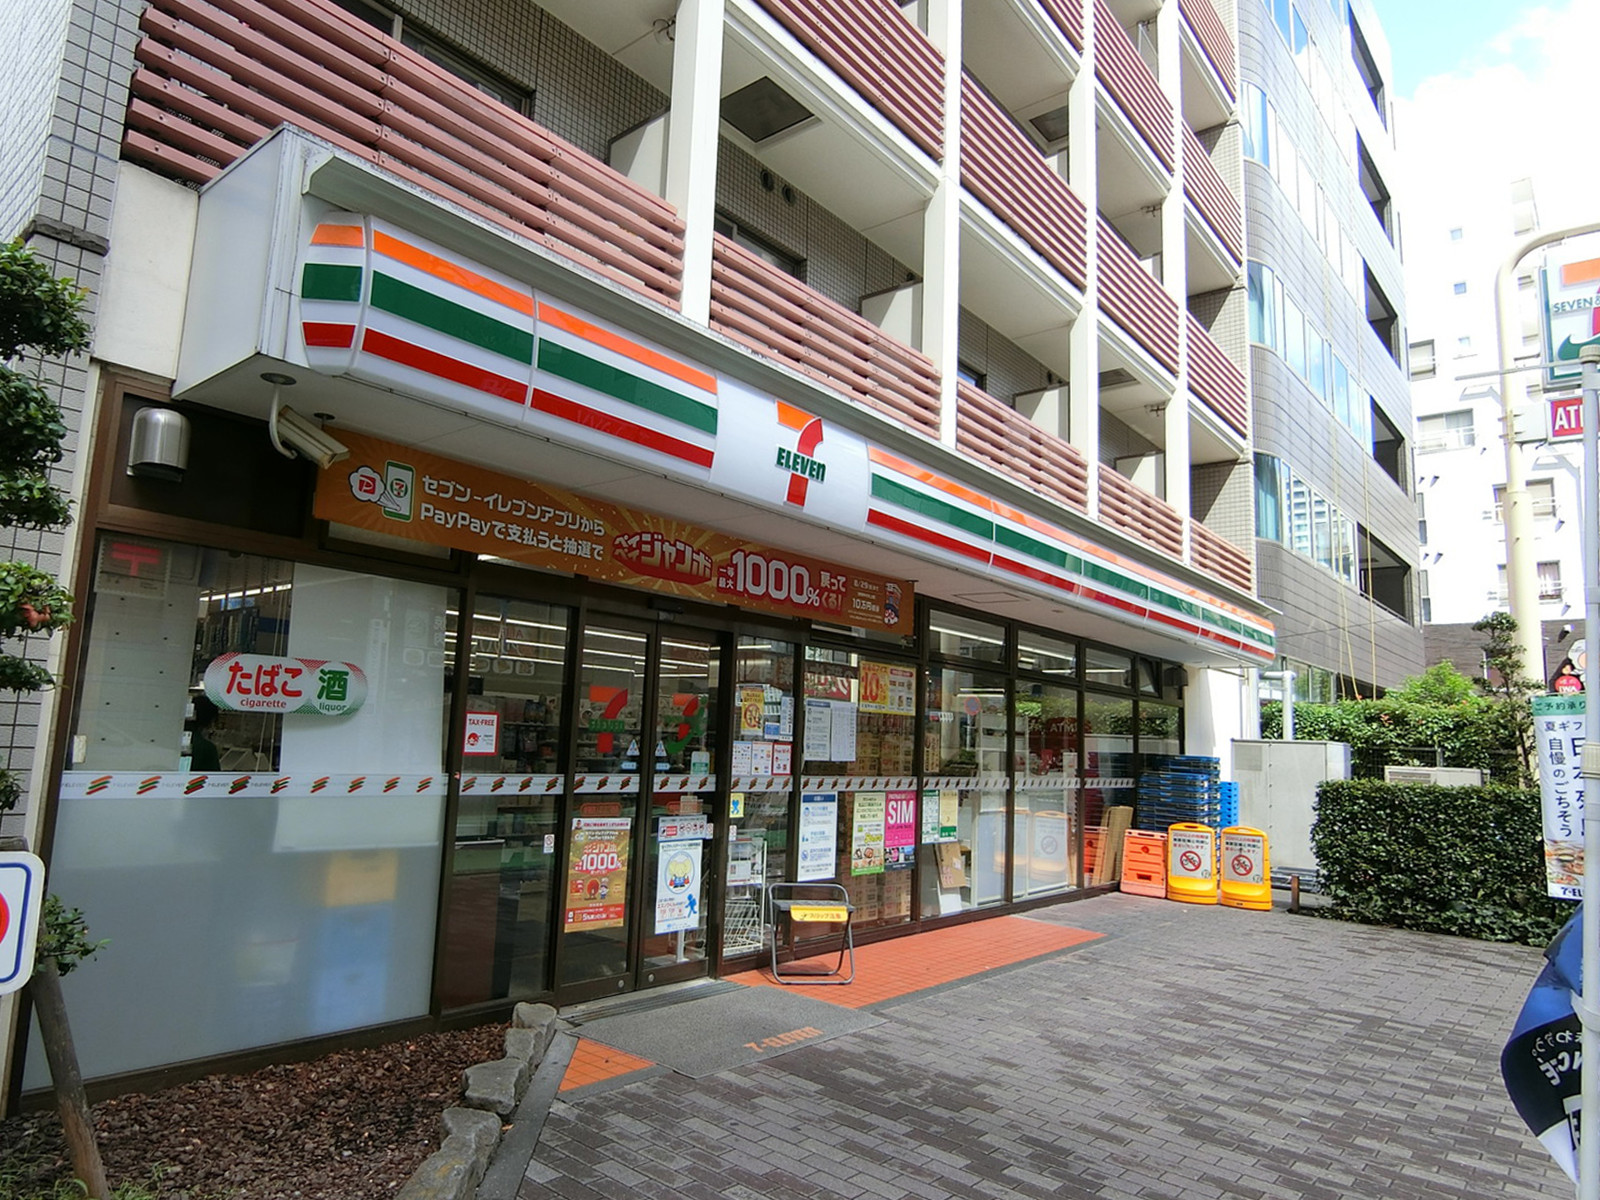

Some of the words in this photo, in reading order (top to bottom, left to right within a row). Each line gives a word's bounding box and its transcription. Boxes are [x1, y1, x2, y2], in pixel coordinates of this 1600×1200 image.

[420, 503, 604, 561] PayPayで支払うと抽選で
[820, 571, 846, 591] 戻って
[226, 661, 302, 697] たばこ
[317, 668, 349, 701] 酒
[240, 697, 287, 708] cigarette
[319, 702, 347, 711] liquor
[1548, 738, 1573, 837] 自慢のごちそう
[887, 800, 915, 824] SIM
